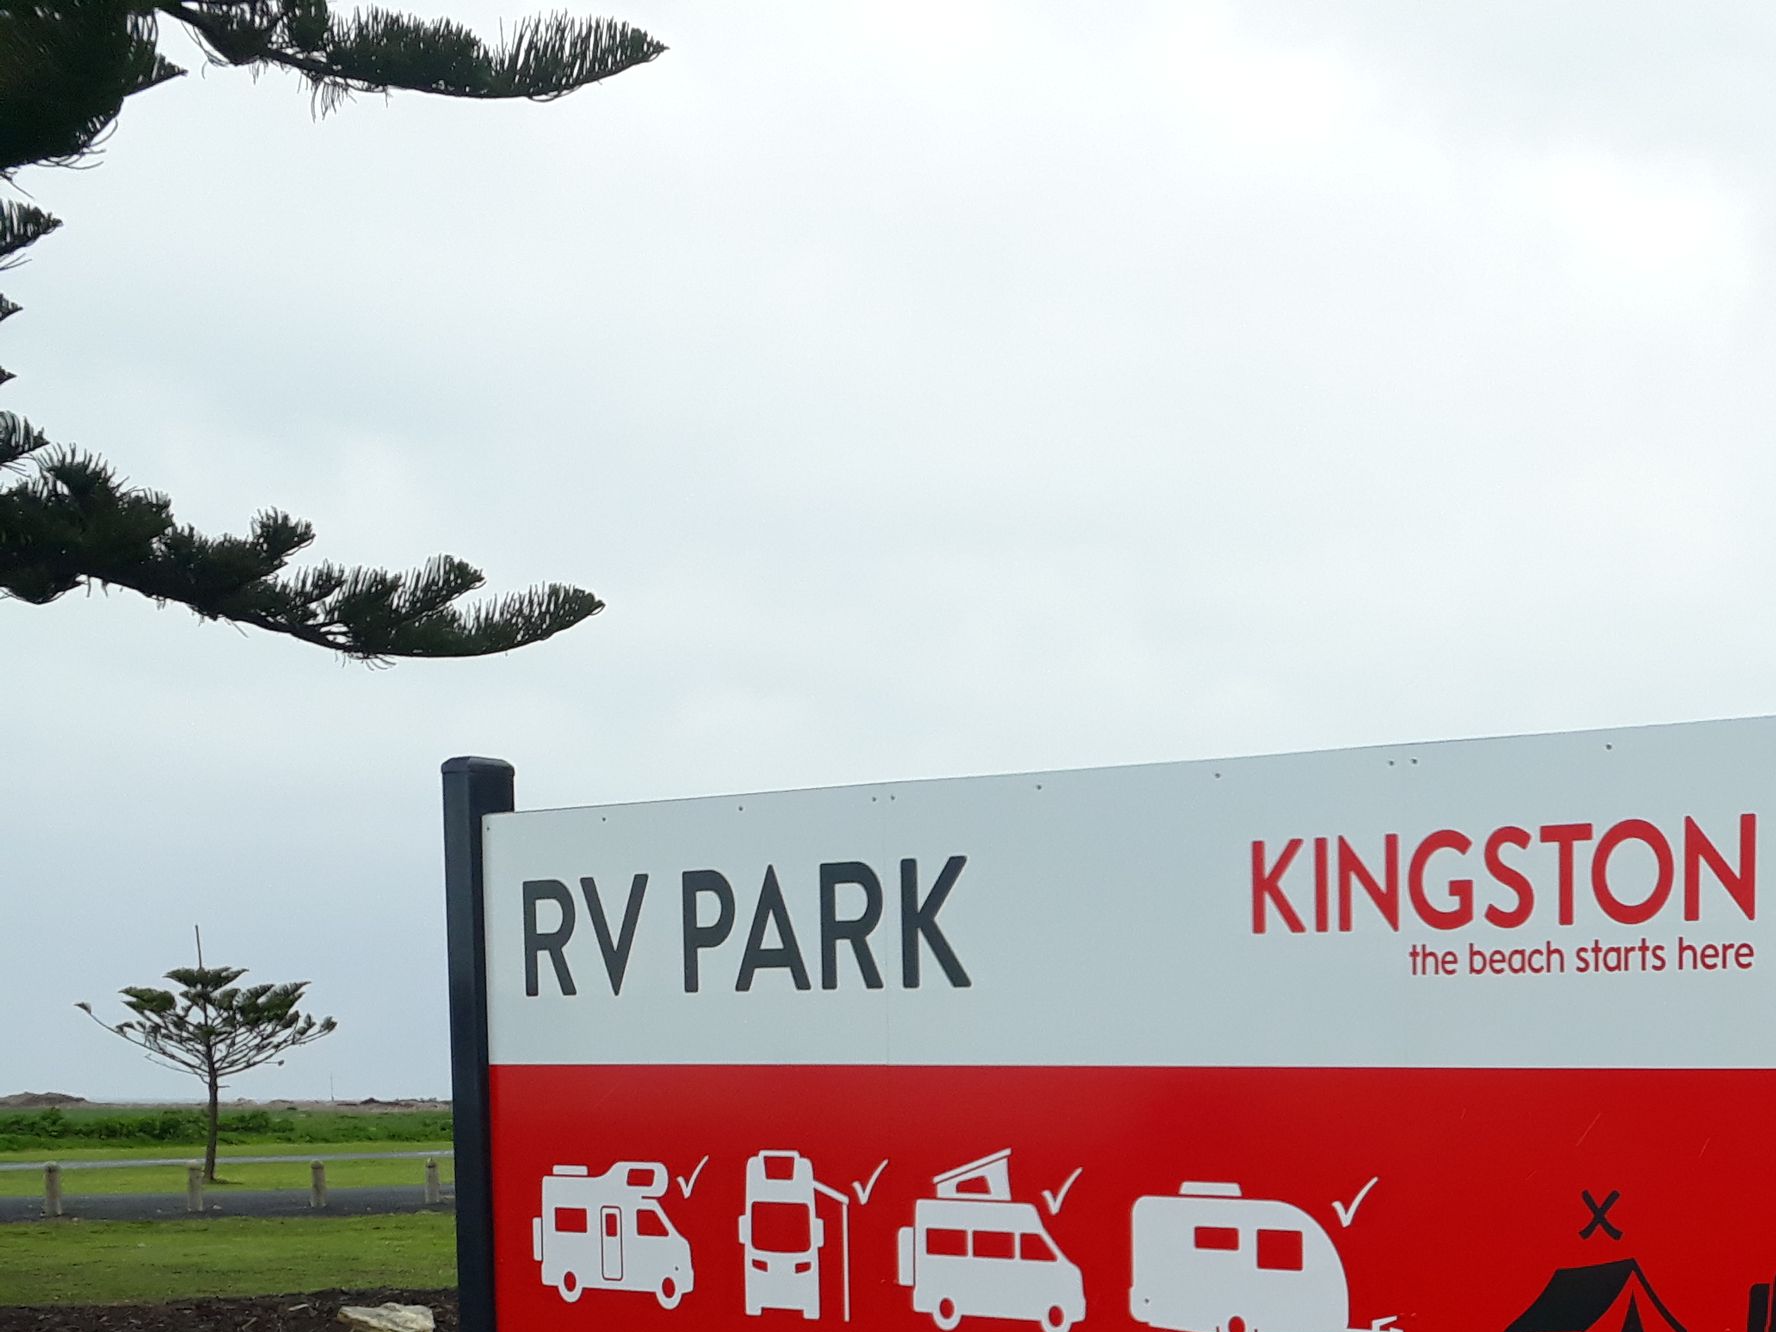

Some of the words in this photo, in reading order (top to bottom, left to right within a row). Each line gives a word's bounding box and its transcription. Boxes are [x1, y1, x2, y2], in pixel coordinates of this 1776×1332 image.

[523, 873, 648, 997] RV
[682, 855, 972, 993] PARK
[1251, 812, 1756, 934] KINGSTON
[1410, 944, 1458, 976] the
[1469, 941, 1564, 976] beach
[1575, 938, 1667, 973] starts
[1678, 938, 1755, 971] here
